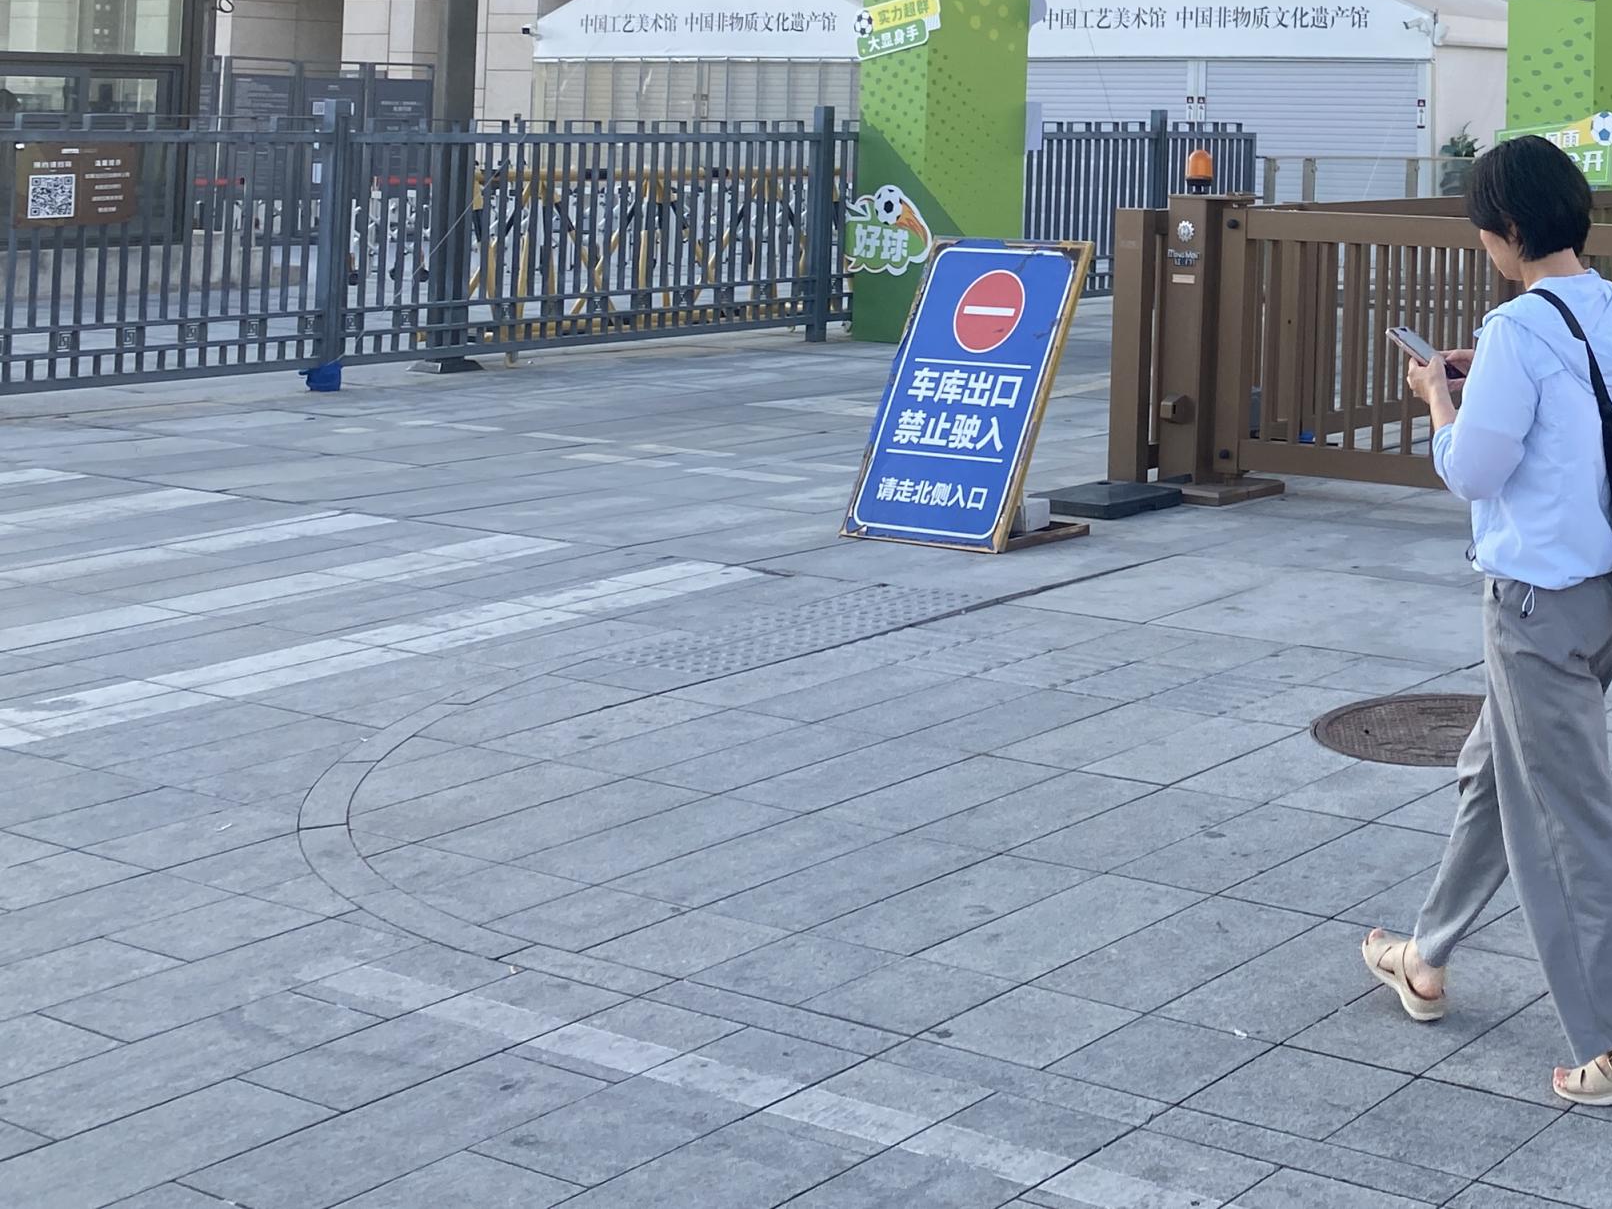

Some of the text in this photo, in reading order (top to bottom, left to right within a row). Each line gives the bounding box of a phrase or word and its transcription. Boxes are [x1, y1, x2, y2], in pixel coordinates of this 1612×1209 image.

[580, 11, 838, 35] 中国工艺美术馆 中国非物质文化遗产馆
[1042, 5, 1370, 31] 中国工艺美术馆 中国非物质文化遗产馆
[867, 24, 919, 53] 大显身手
[853, 223, 909, 263] 好球
[907, 366, 1024, 409] 车库出口
[892, 409, 1004, 453] 禁止驶入
[875, 476, 989, 511] 请走北侧入口
